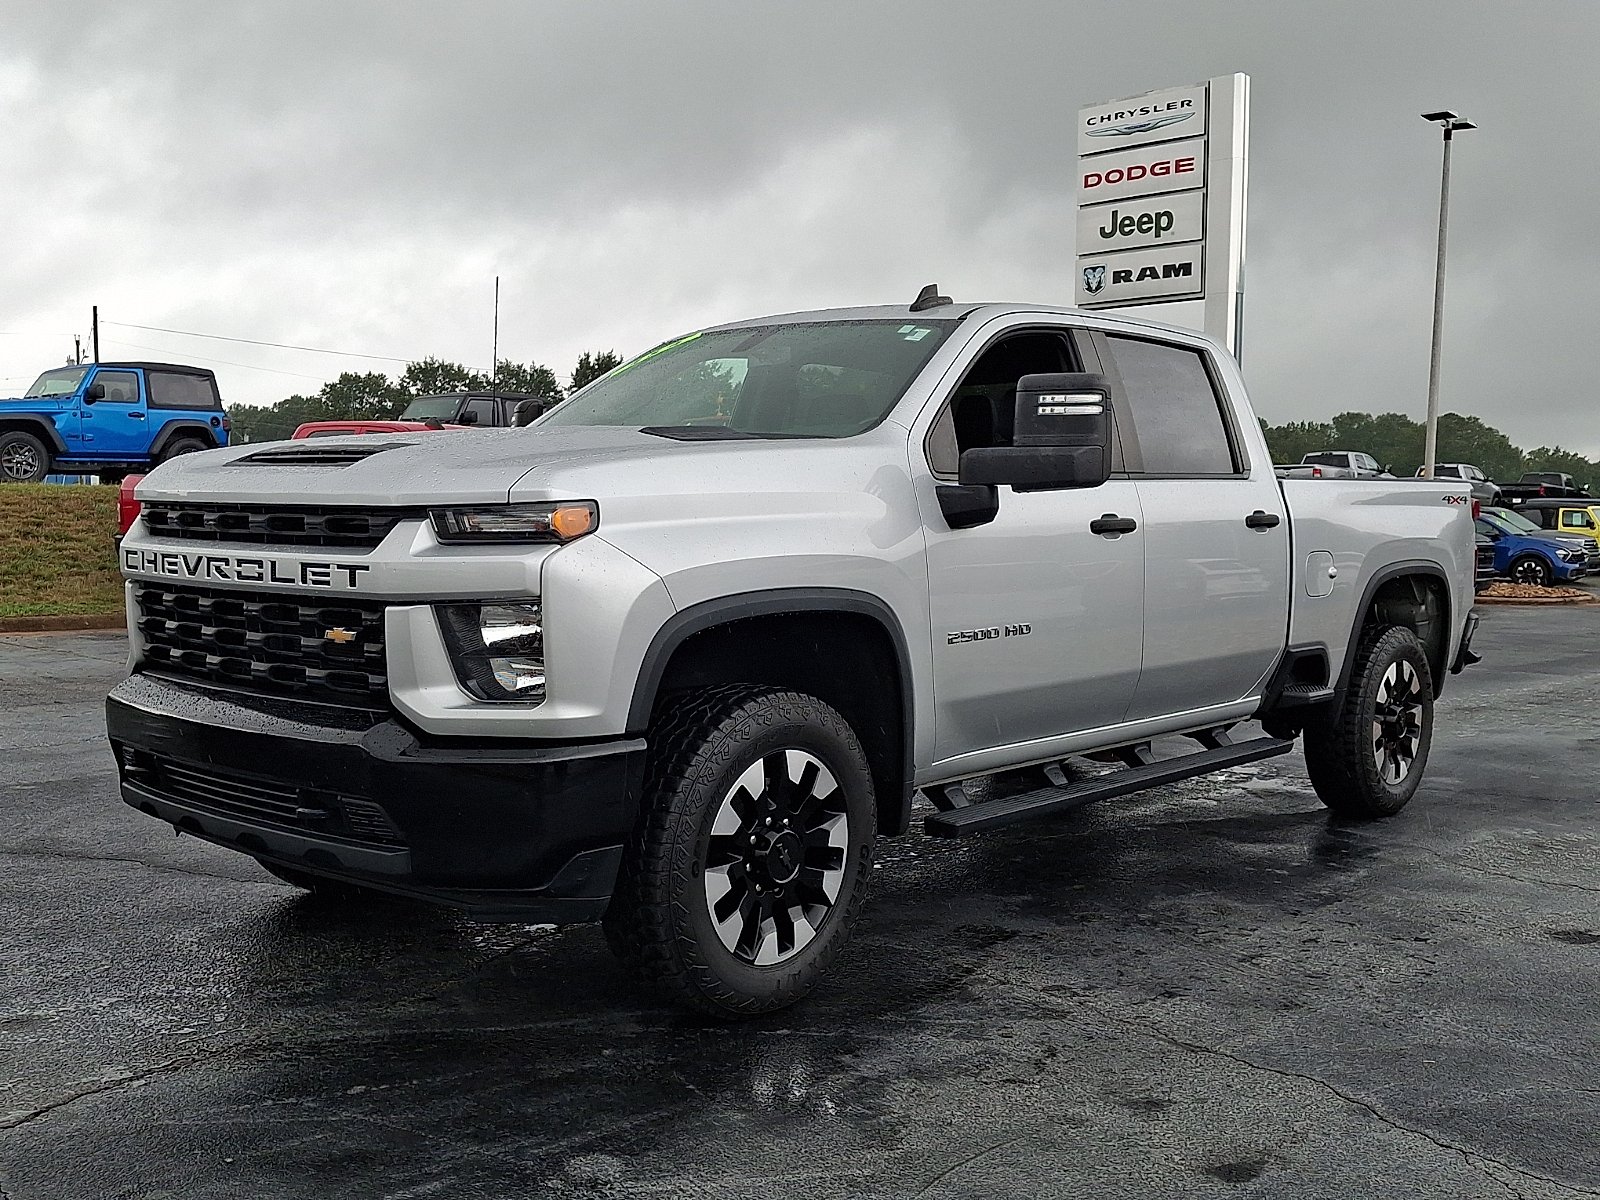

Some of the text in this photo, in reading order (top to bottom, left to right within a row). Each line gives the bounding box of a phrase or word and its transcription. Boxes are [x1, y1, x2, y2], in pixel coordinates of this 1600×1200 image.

[1086, 99, 1193, 126] CHRYSLER
[1083, 157, 1195, 189] DODGE
[1099, 209, 1174, 239] Jeep
[1112, 262, 1193, 285] RAM
[124, 549, 370, 589] CHEVROLET
[947, 623, 1032, 645] 2500 HD
